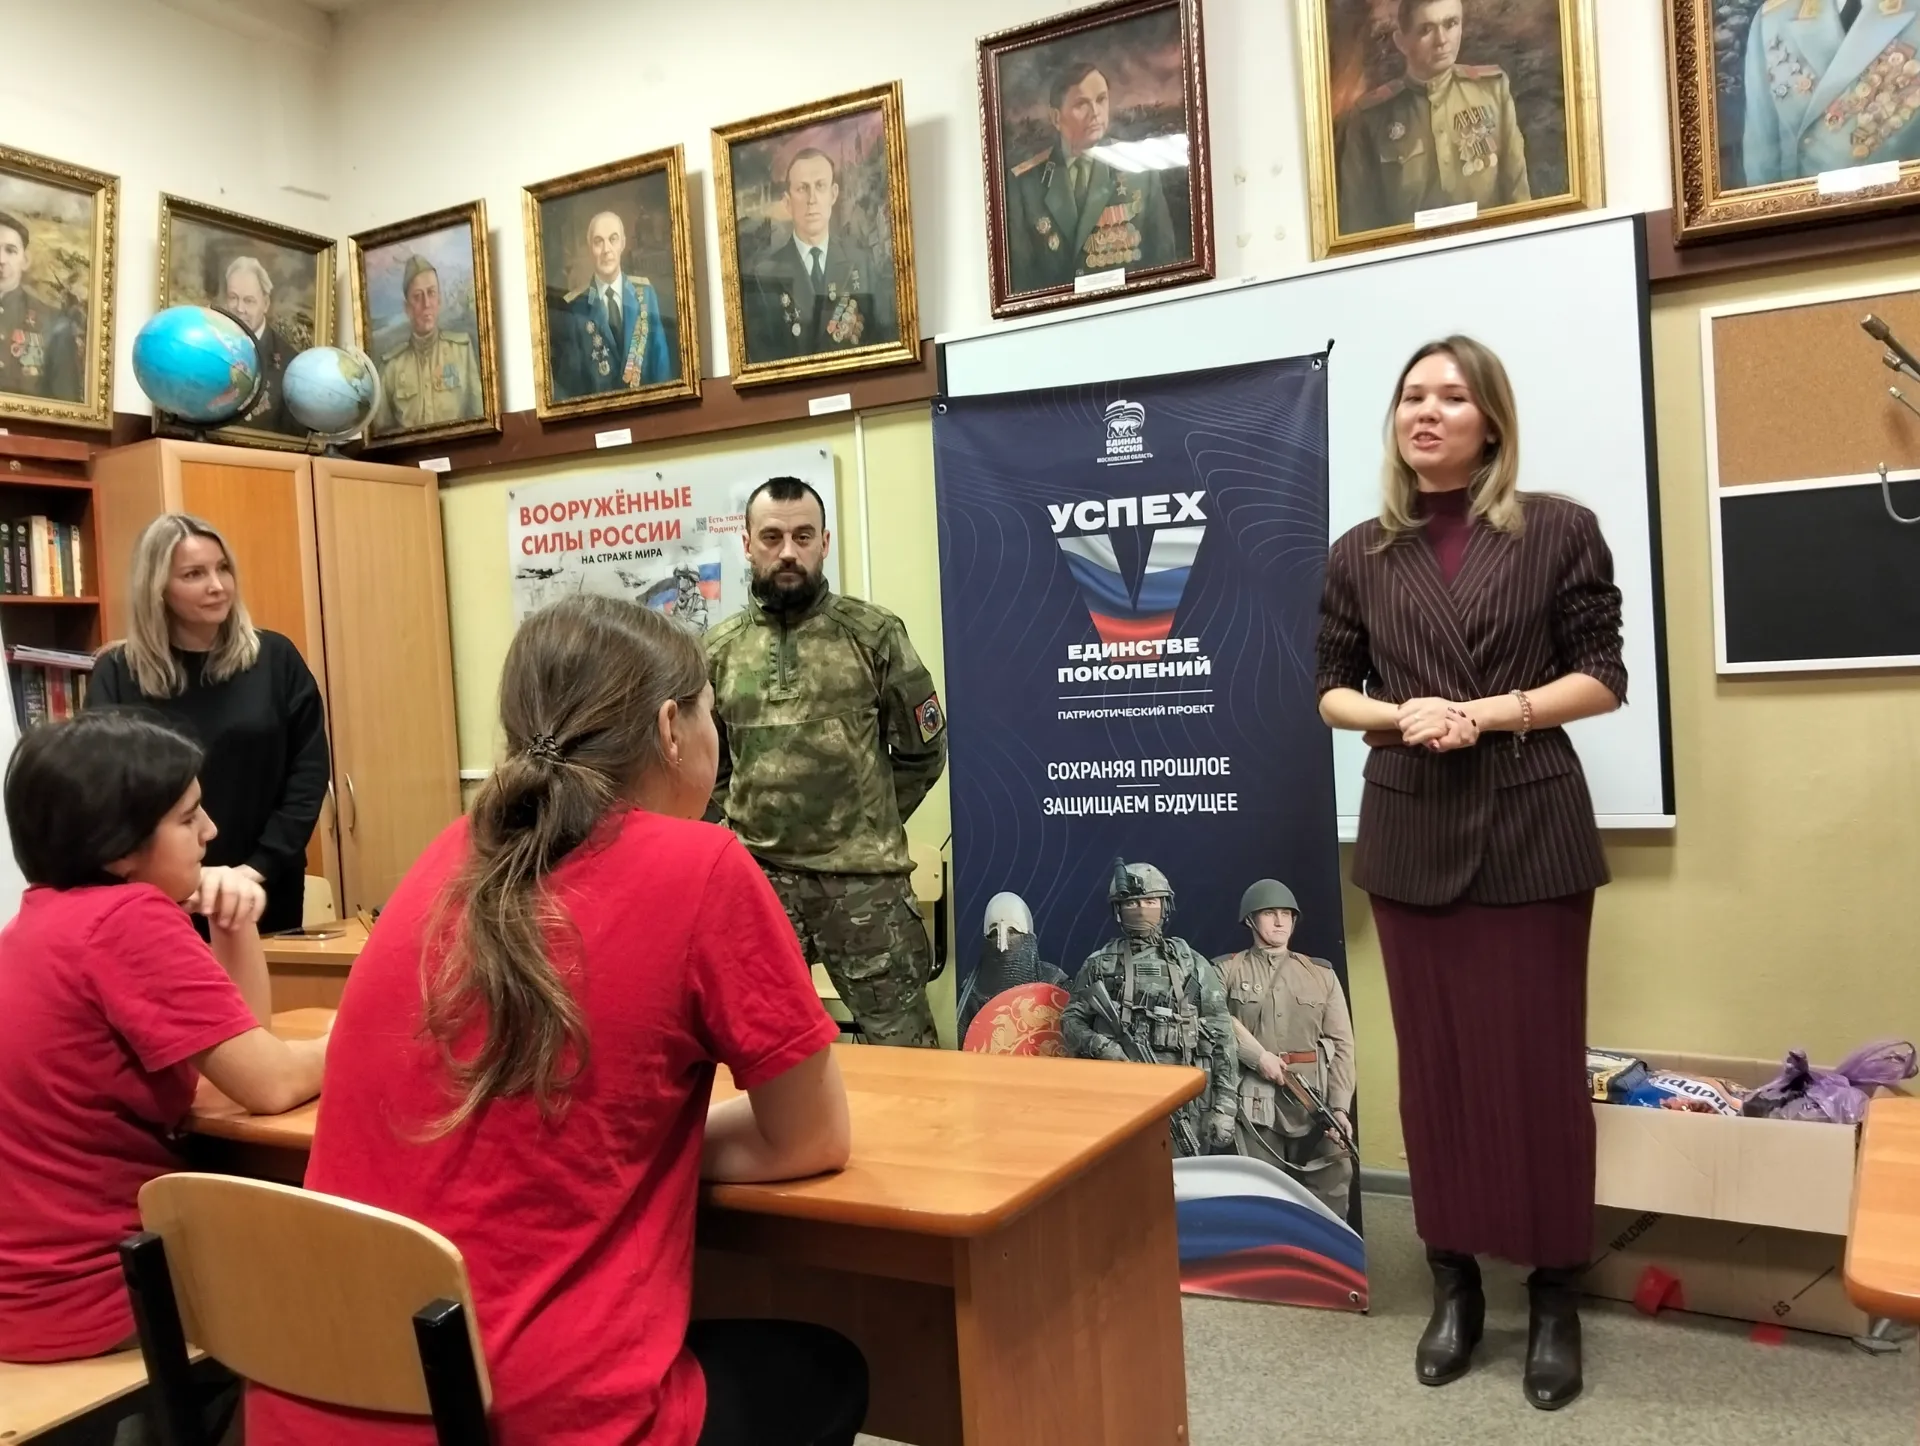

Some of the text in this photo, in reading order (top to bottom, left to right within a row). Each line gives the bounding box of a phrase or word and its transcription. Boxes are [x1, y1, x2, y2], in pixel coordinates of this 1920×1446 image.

[1105, 436, 1143, 447] ЕДИНАЯ
[1106, 444, 1143, 455] РОССИЯ
[1096, 455, 1130, 463] МОСКОВСКАЯ
[520, 486, 692, 526] ВООРУЖЁННЫЕ
[1047, 490, 1207, 533] УСПЕХ
[708, 516, 724, 524] Есть
[709, 525, 738, 534] Родину
[521, 519, 681, 556] СИЛЫ РОССИИ
[581, 548, 663, 565] НА СТРАЖЕ МИРА
[1067, 637, 1200, 661] ЕДИНСТВЕ
[1058, 655, 1211, 683] ПОКОЛЕНИЙ
[1057, 704, 1215, 720] ПАТРИОТИЧЕСКИЙ ПРОЕКТ
[1047, 757, 1231, 780] СОХРАНЯЯ ПРОШЛОЕ
[1043, 793, 1238, 817] ЗАЩИЩАЕМ БУДУЩЕЕ
[1659, 1078, 1728, 1115] happi
